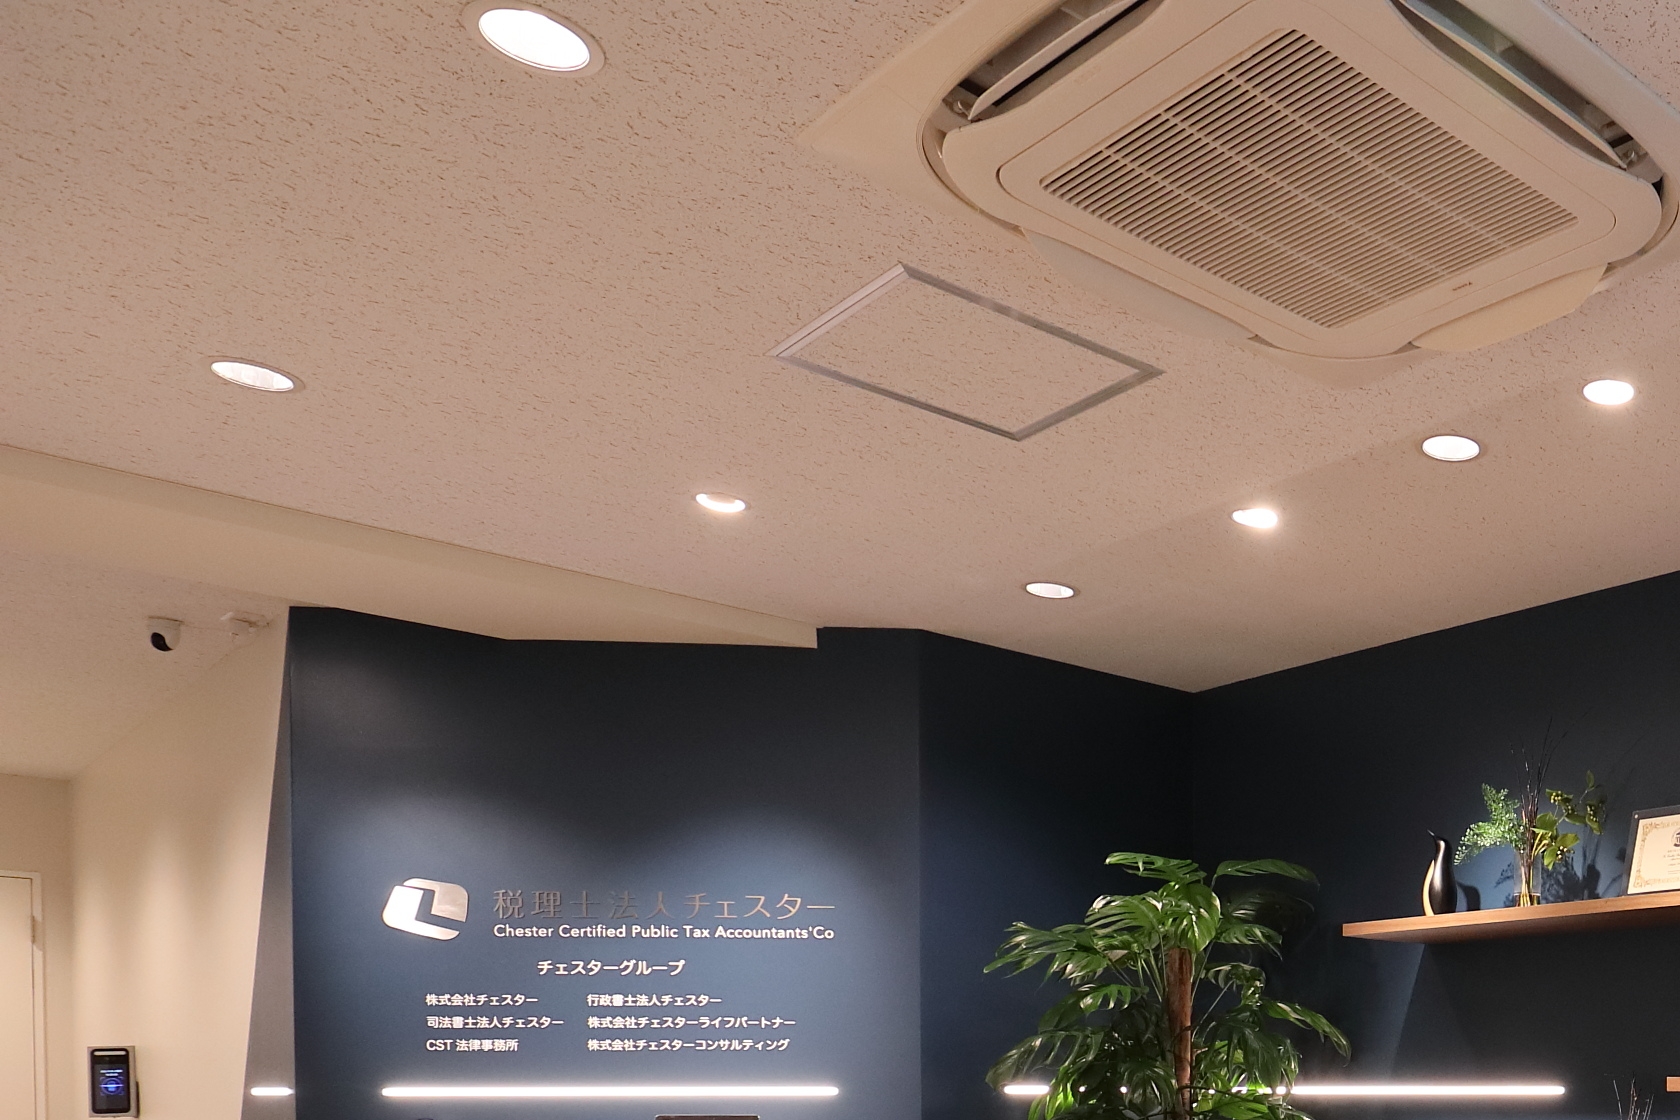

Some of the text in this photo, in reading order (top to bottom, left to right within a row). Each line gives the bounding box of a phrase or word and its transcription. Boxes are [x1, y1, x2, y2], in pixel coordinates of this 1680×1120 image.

[493, 889, 836, 920] 税理士法人チェスター
[493, 924, 554, 938] Chester
[558, 924, 626, 938] Certified
[631, 924, 679, 938] Public
[683, 925, 711, 938] Tax
[537, 959, 686, 976] チェスターグループ
[425, 993, 539, 1006] 株式会社チェスター
[586, 994, 722, 1007] 行政書士法人チェスター
[426, 1016, 565, 1029] 司法書士法人チェスター
[586, 1016, 796, 1029] 株式会社チェスターライフパートナー
[426, 1038, 519, 1052] CST 法律事務所
[586, 1038, 790, 1051] 株式会社チェスターコンサルティング
